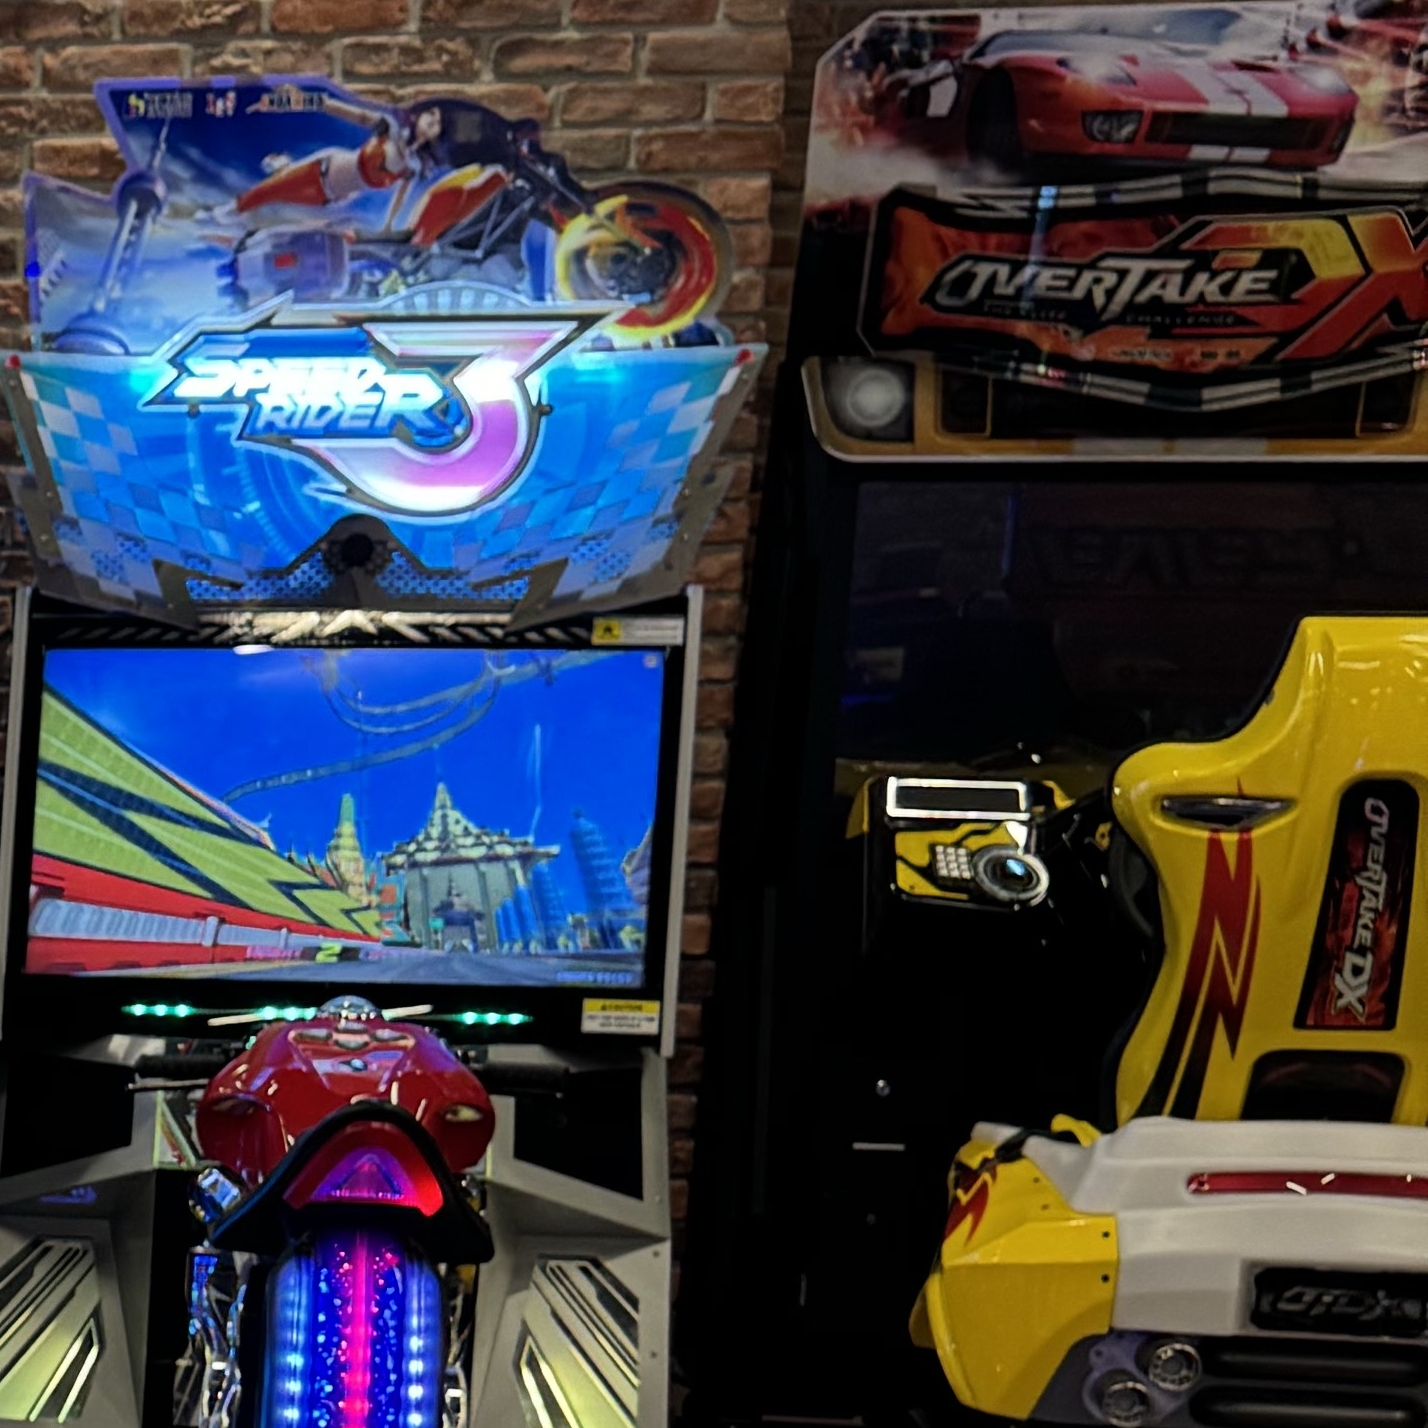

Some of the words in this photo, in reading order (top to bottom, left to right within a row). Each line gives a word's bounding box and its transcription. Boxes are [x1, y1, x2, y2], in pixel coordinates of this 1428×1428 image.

[174, 357, 386, 398] SPEED
[255, 374, 445, 430] RIDER
[315, 943, 343, 963] 2
[1331, 952, 1373, 1020] DX
